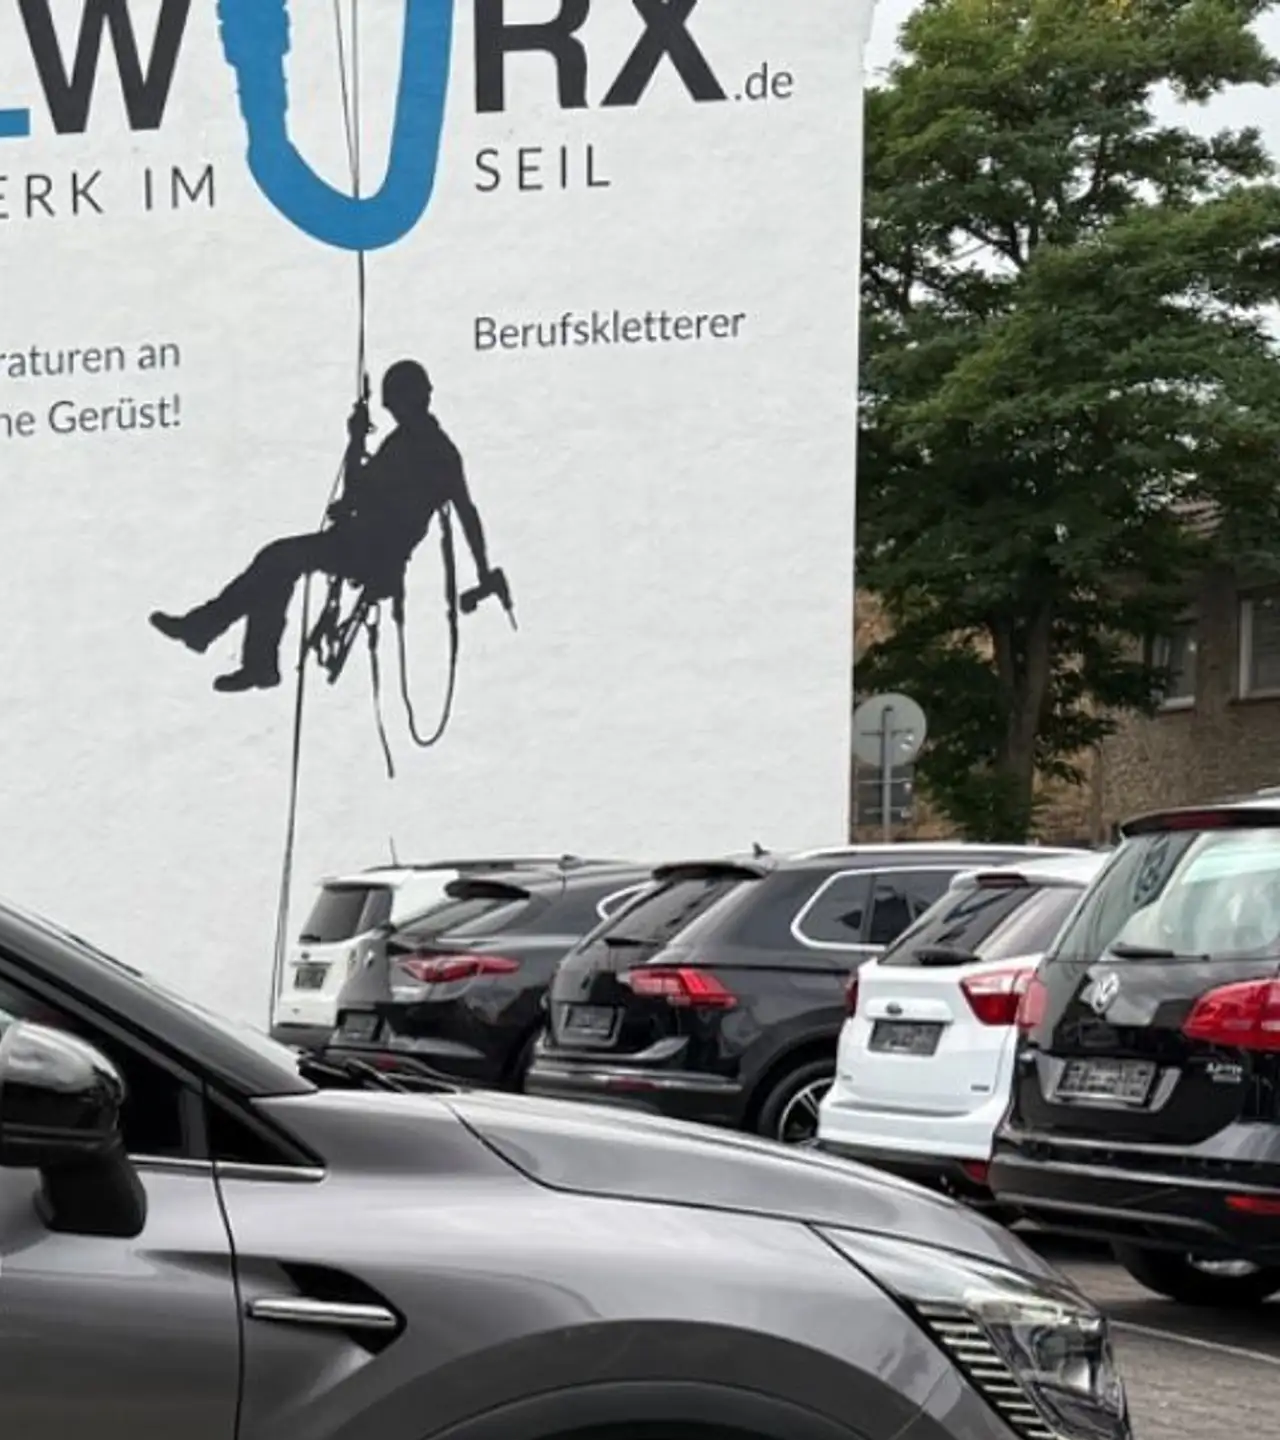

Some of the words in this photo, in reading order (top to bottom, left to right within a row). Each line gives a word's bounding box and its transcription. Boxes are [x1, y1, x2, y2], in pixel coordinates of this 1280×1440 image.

[143, 163, 216, 211] IM
[474, 143, 612, 193] SEIL
[473, 308, 748, 353] Berufskletterer
[136, 342, 181, 371] an
[47, 392, 182, 435] Gerüst!
